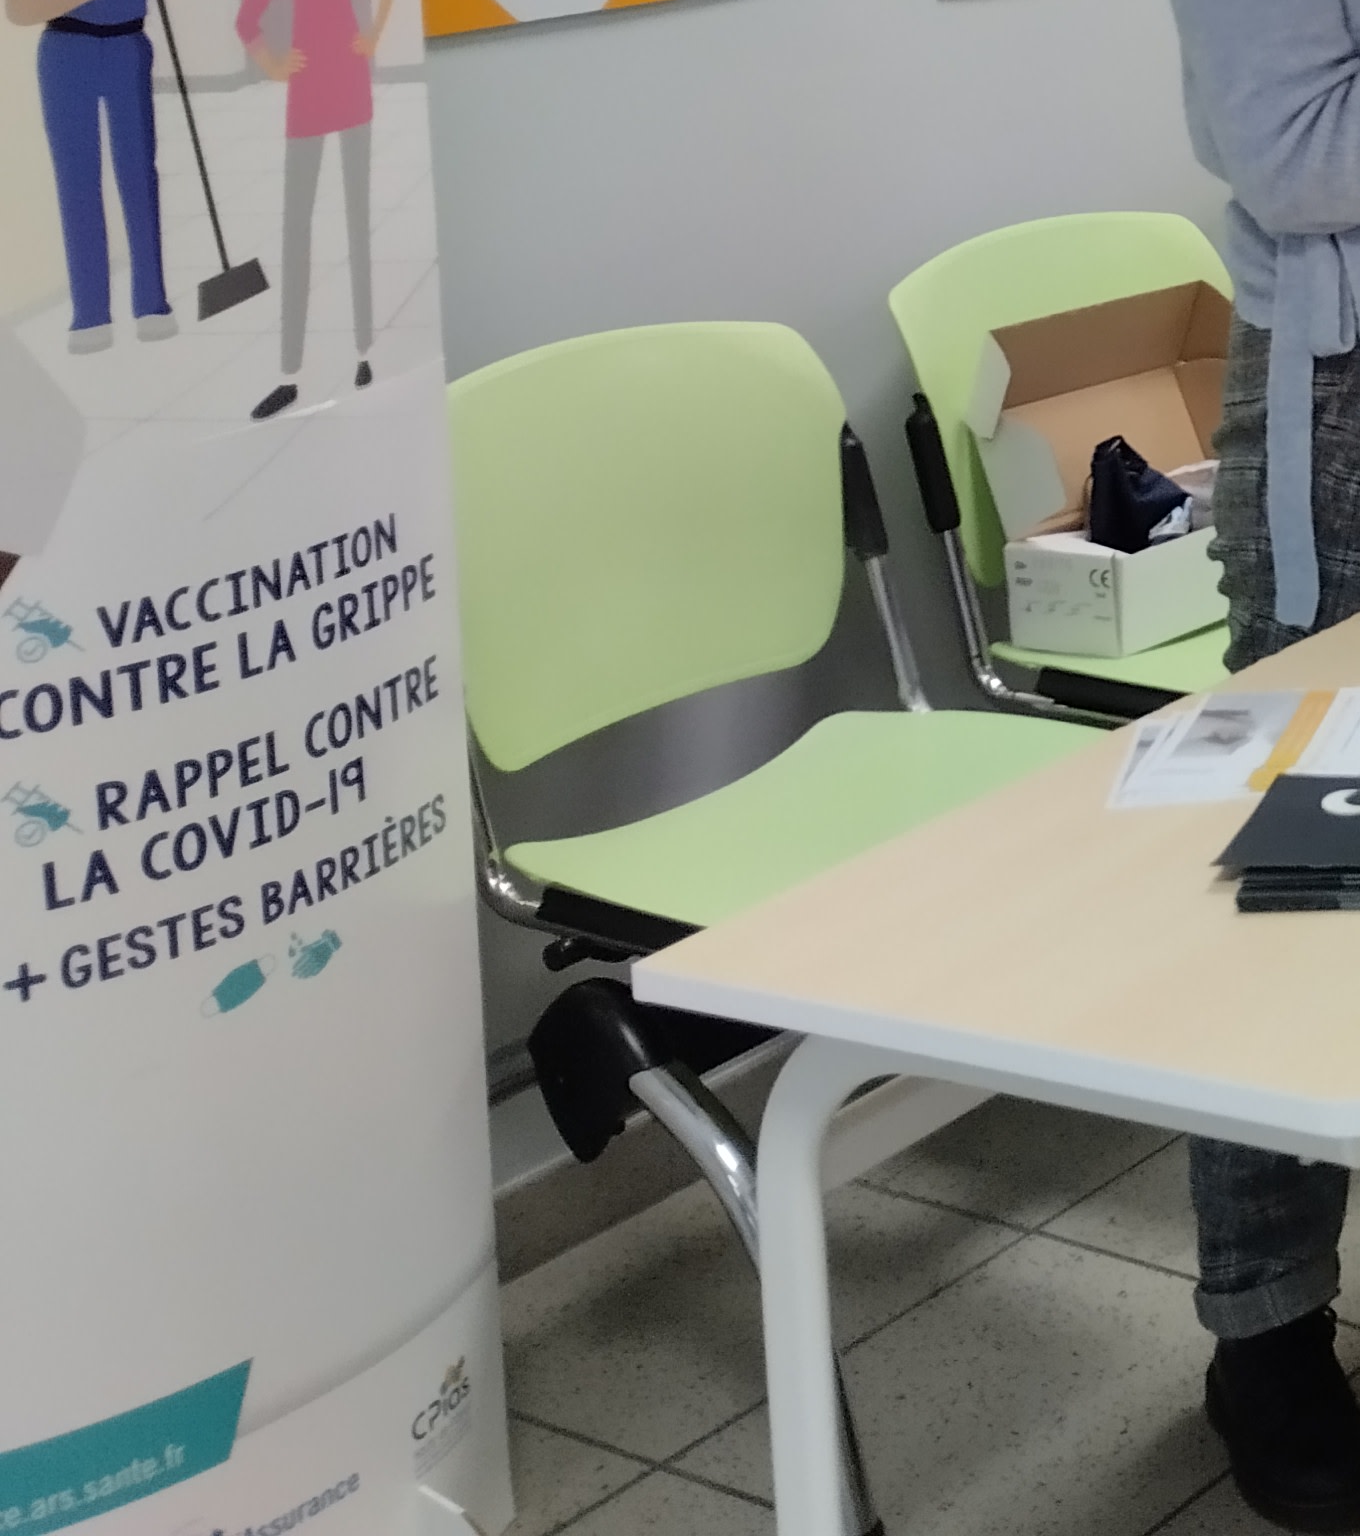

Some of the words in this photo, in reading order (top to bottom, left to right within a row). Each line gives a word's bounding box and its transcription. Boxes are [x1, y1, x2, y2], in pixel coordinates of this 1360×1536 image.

[0, 641, 220, 740] CONTRE
[237, 619, 297, 680] LA
[311, 553, 437, 651] GRIPPE
[96, 512, 398, 648] VACCINATION
[95, 730, 291, 831] RAPPEL
[304, 654, 440, 758] CONTRE
[42, 849, 120, 911] LA
[140, 756, 367, 881] COVID-19
[60, 895, 246, 990] GESTES
[261, 793, 448, 926] BARRIÈRES
